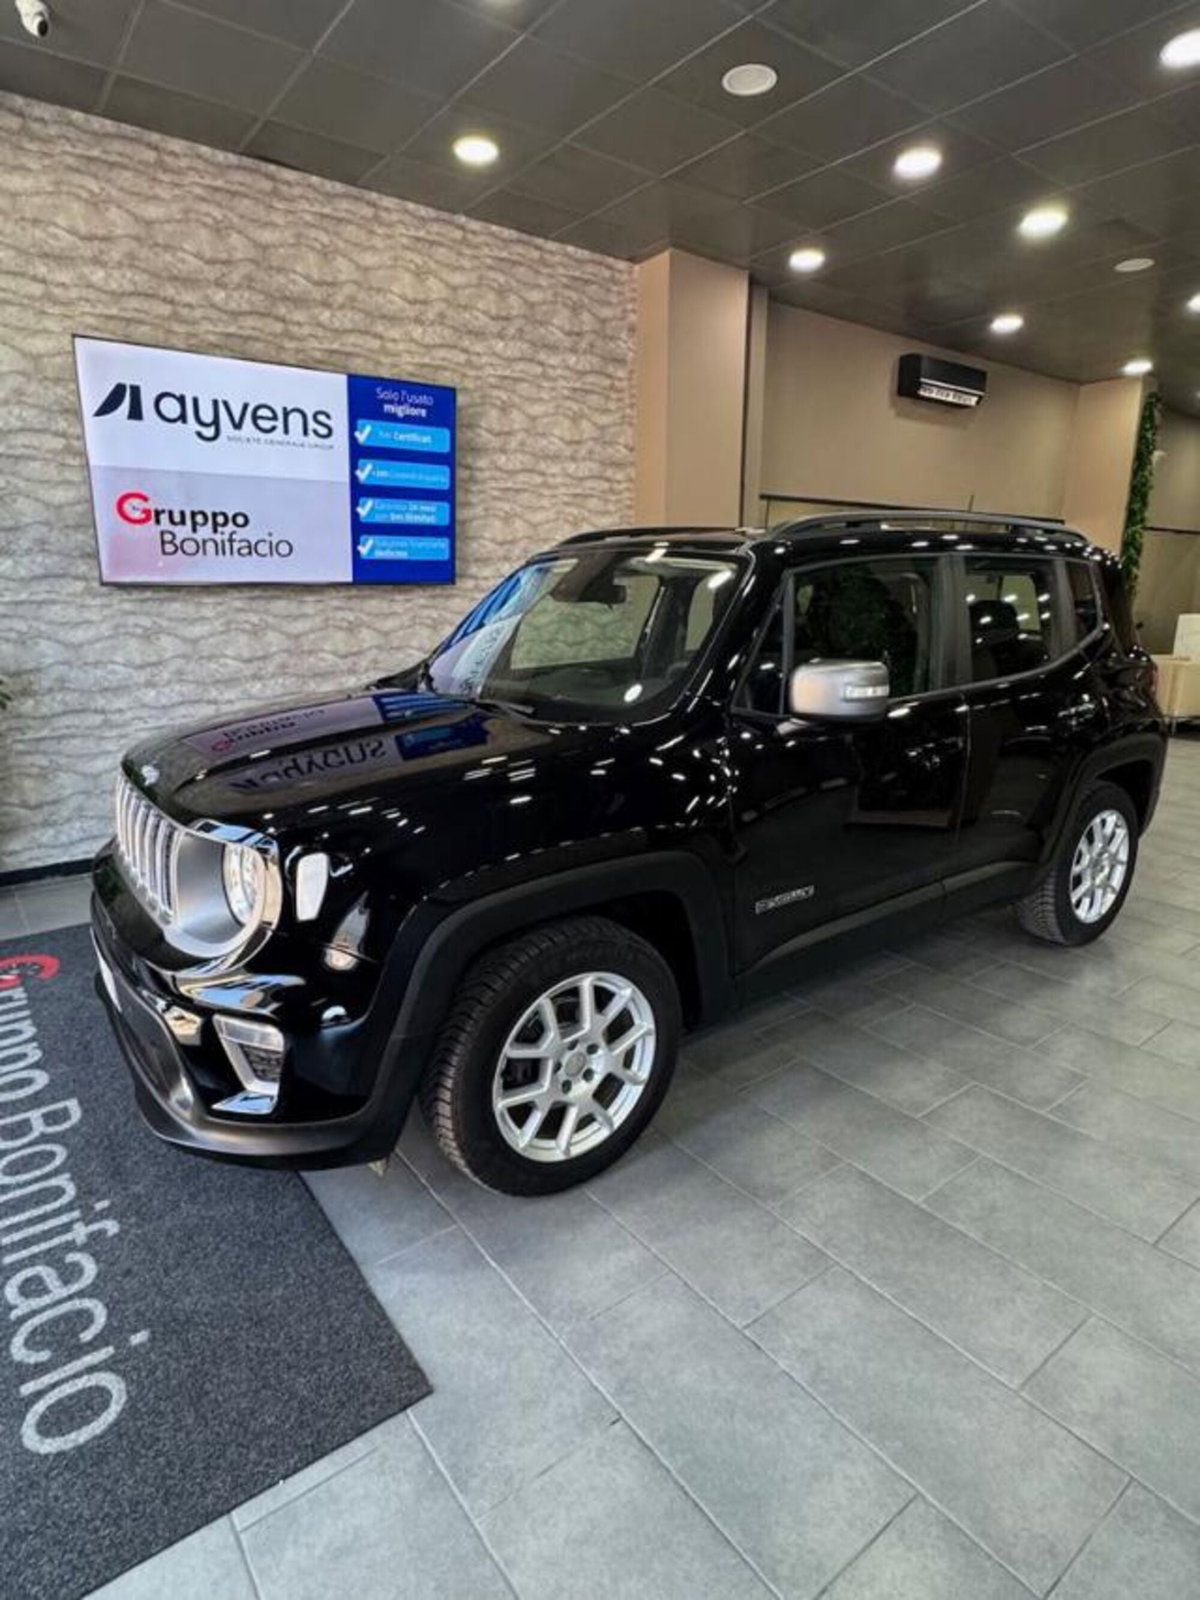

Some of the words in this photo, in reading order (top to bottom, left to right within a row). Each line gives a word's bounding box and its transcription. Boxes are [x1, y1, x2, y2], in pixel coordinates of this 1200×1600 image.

[153, 390, 334, 443] ayvens
[383, 404, 428, 418] migliore
[115, 491, 250, 534] Gruppo
[159, 529, 294, 558] Bonifacio
[0, 1098, 150, 1456] Bonifacio
